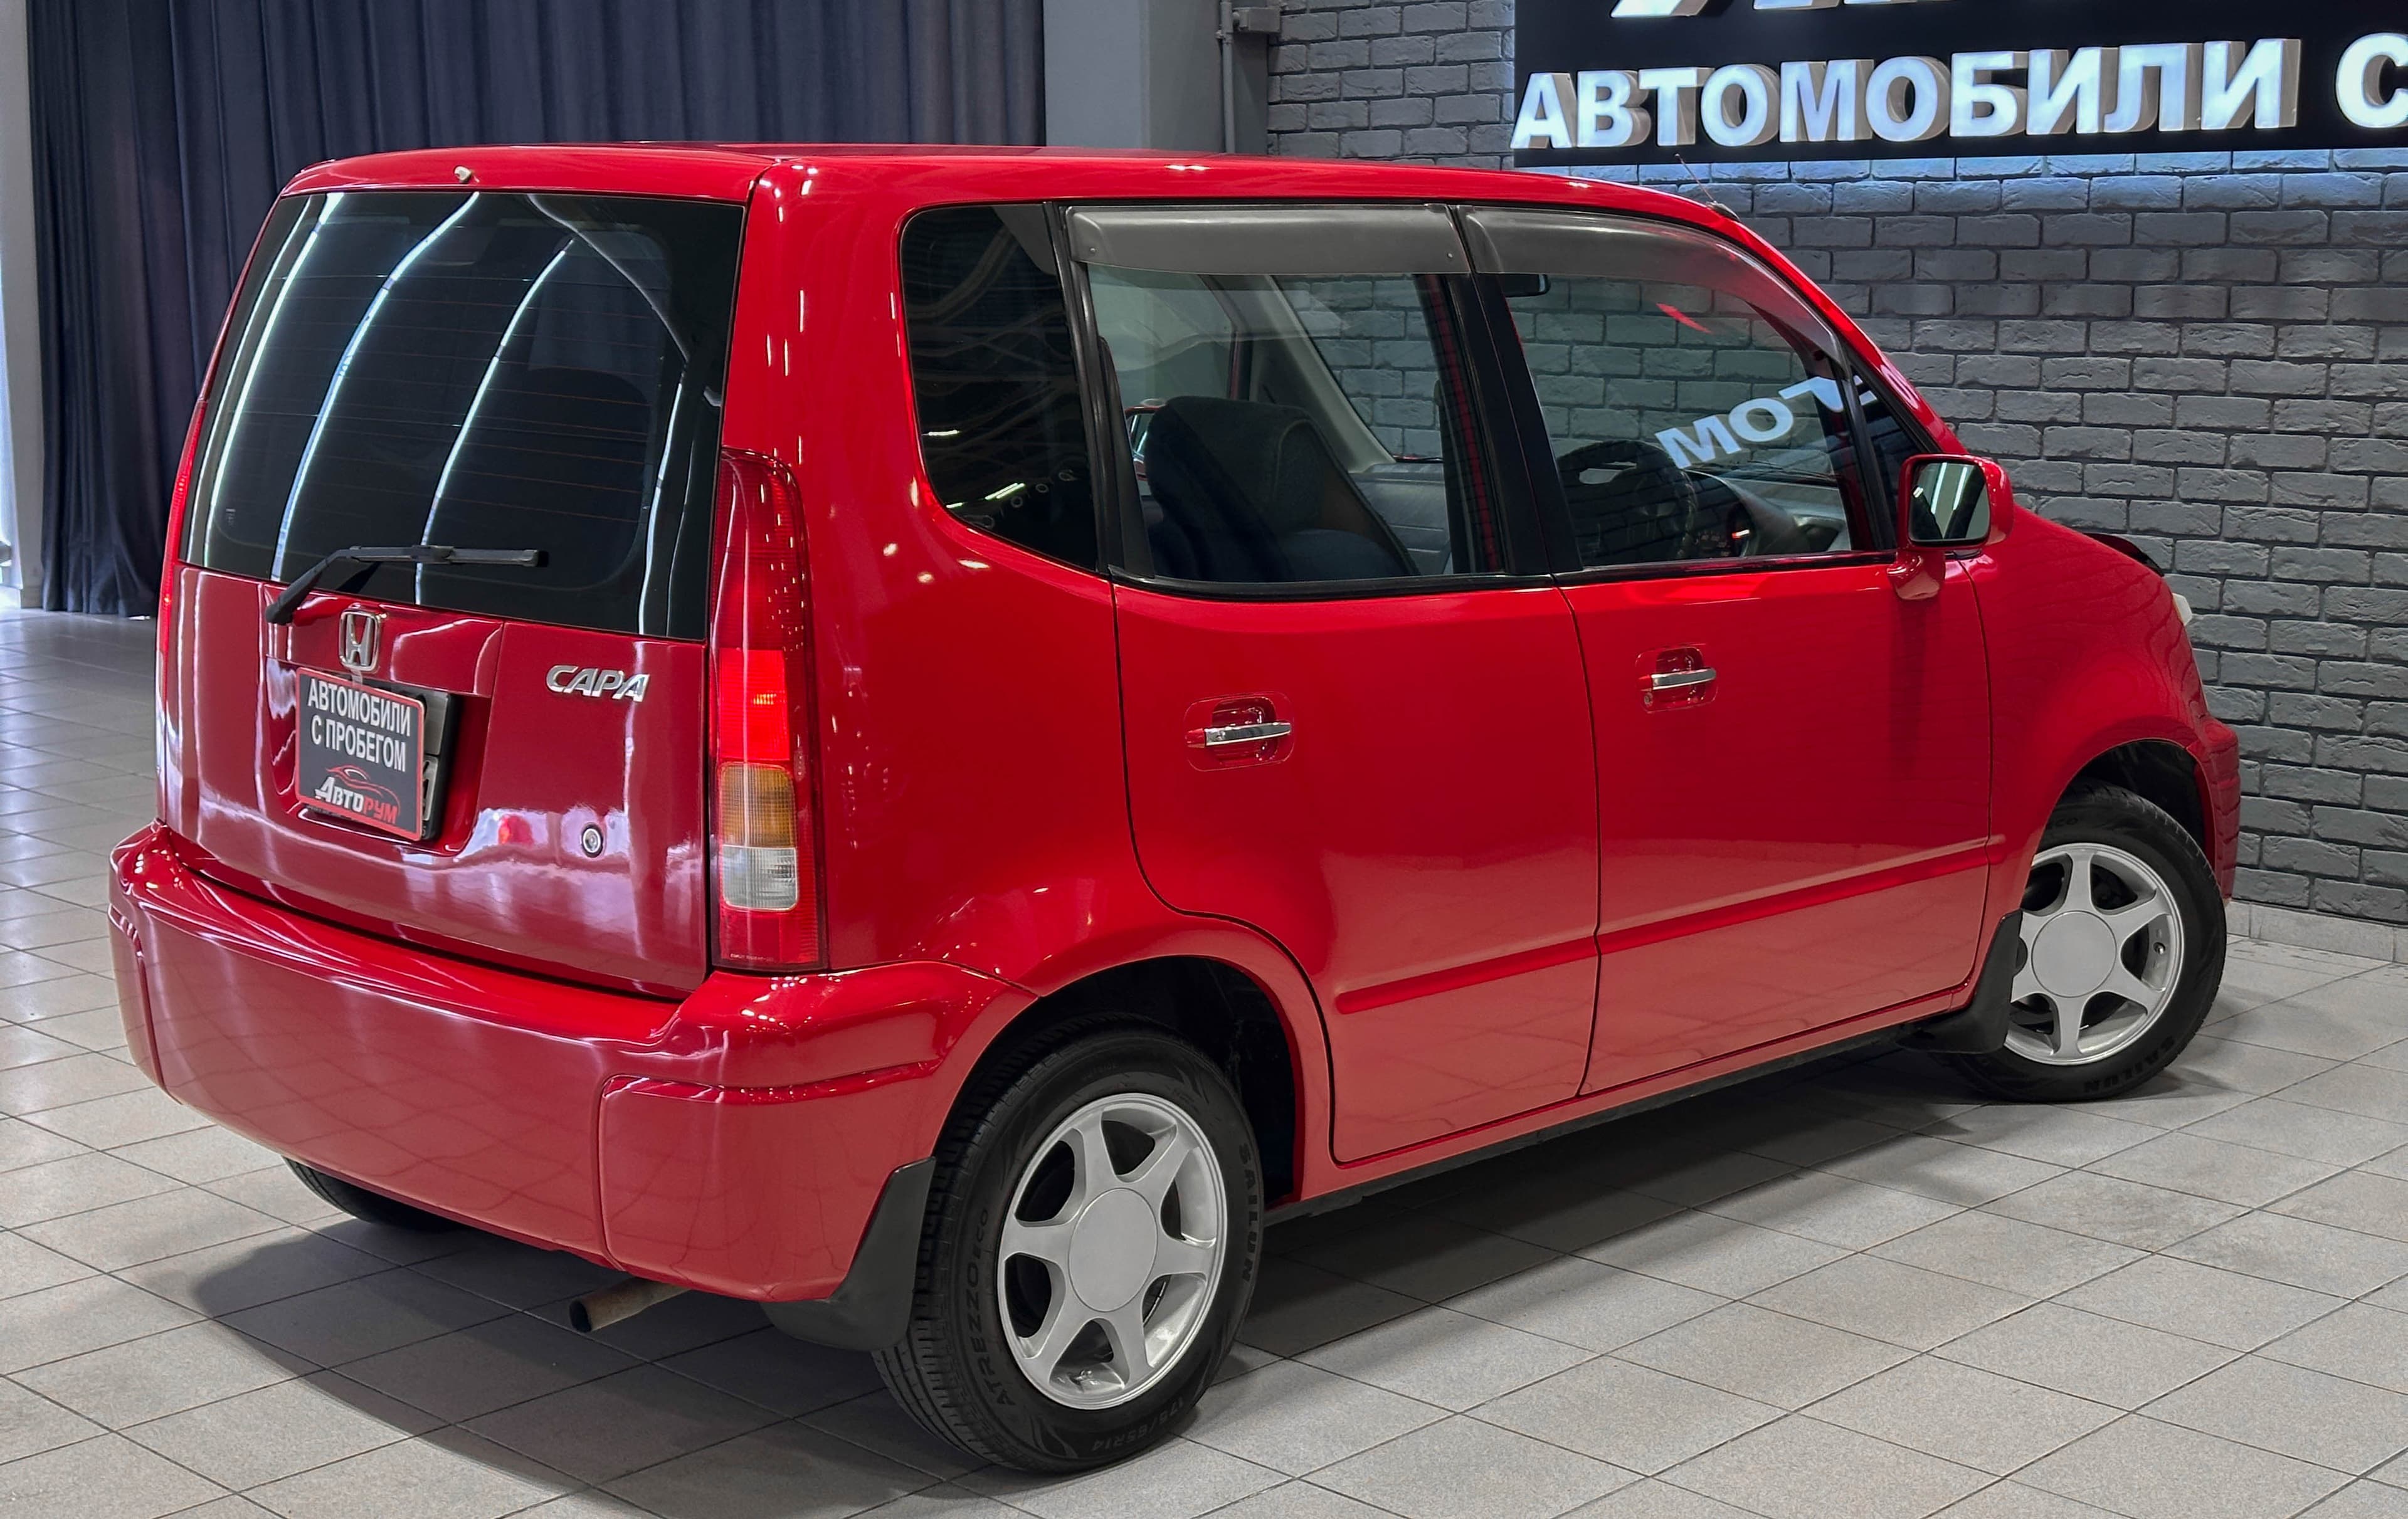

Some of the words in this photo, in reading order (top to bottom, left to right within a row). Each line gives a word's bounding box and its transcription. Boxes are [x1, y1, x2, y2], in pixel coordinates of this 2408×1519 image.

[1510, 38, 2293, 149] АВТОМОБИЛИ
[2335, 32, 2408, 128] С
[307, 678, 411, 737] АВТОМОБИЛИ
[546, 665, 650, 703] CAPA
[311, 715, 322, 745] С
[325, 718, 406, 772] ПРОБЕГОМ
[1238, 1142, 1258, 1283] SAILUN
[966, 1261, 1016, 1407] ATREZZO
